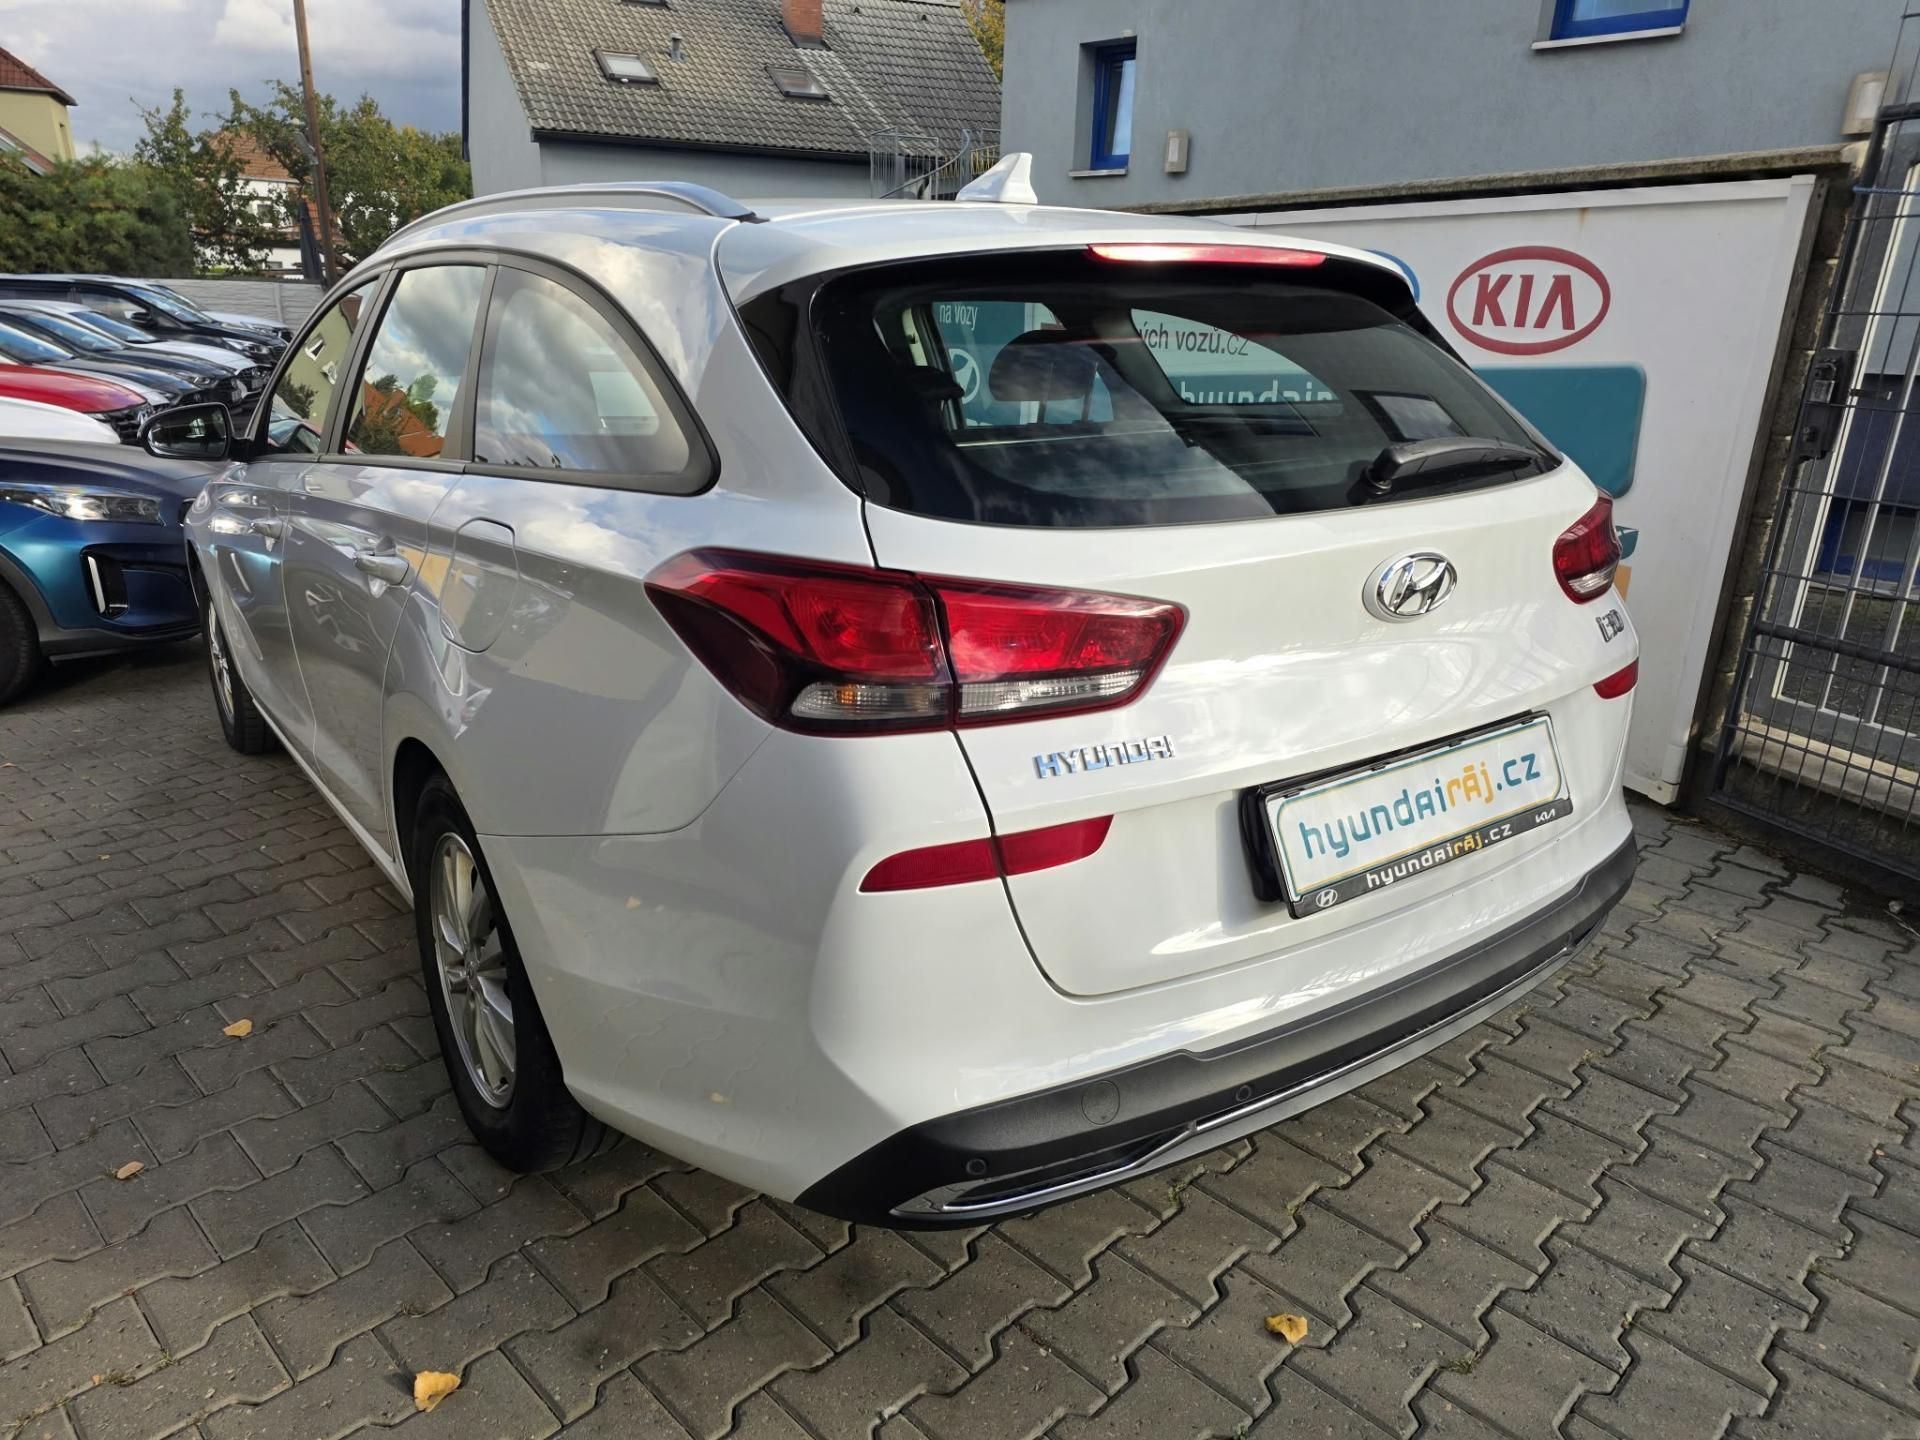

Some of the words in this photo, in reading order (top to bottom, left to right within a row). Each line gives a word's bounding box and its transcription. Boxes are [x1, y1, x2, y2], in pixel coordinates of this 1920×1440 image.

[939, 304, 952, 324] na
[954, 304, 978, 331] vozy
[1472, 274, 1576, 330] KIA
[1032, 735, 1177, 779] HYUNDAI
